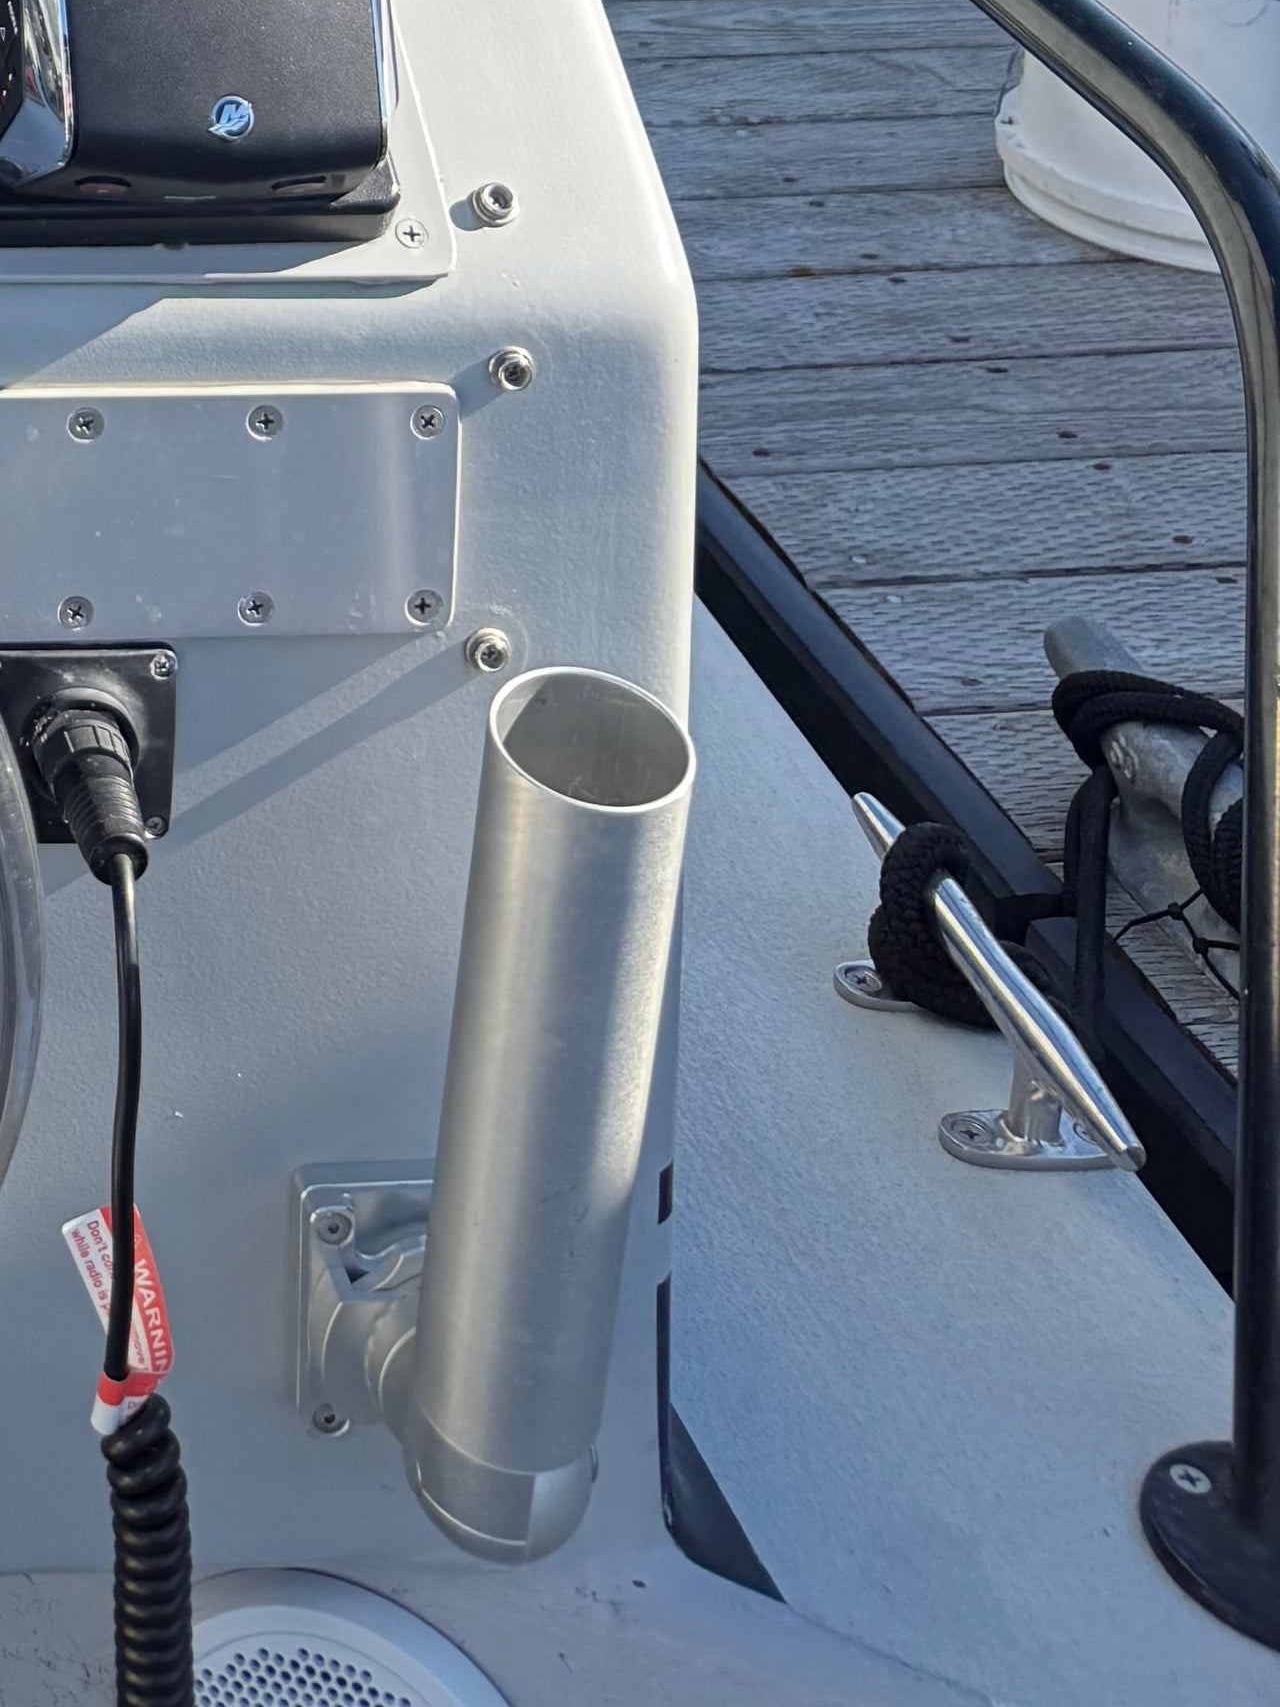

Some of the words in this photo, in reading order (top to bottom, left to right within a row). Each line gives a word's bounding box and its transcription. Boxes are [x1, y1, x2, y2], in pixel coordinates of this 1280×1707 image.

[70, 1228, 88, 1258] while
[84, 1260, 103, 1288] radio
[98, 1290, 109, 1303] is
[87, 1220, 108, 1255] Don't
[134, 1259, 169, 1373] WARNIN
